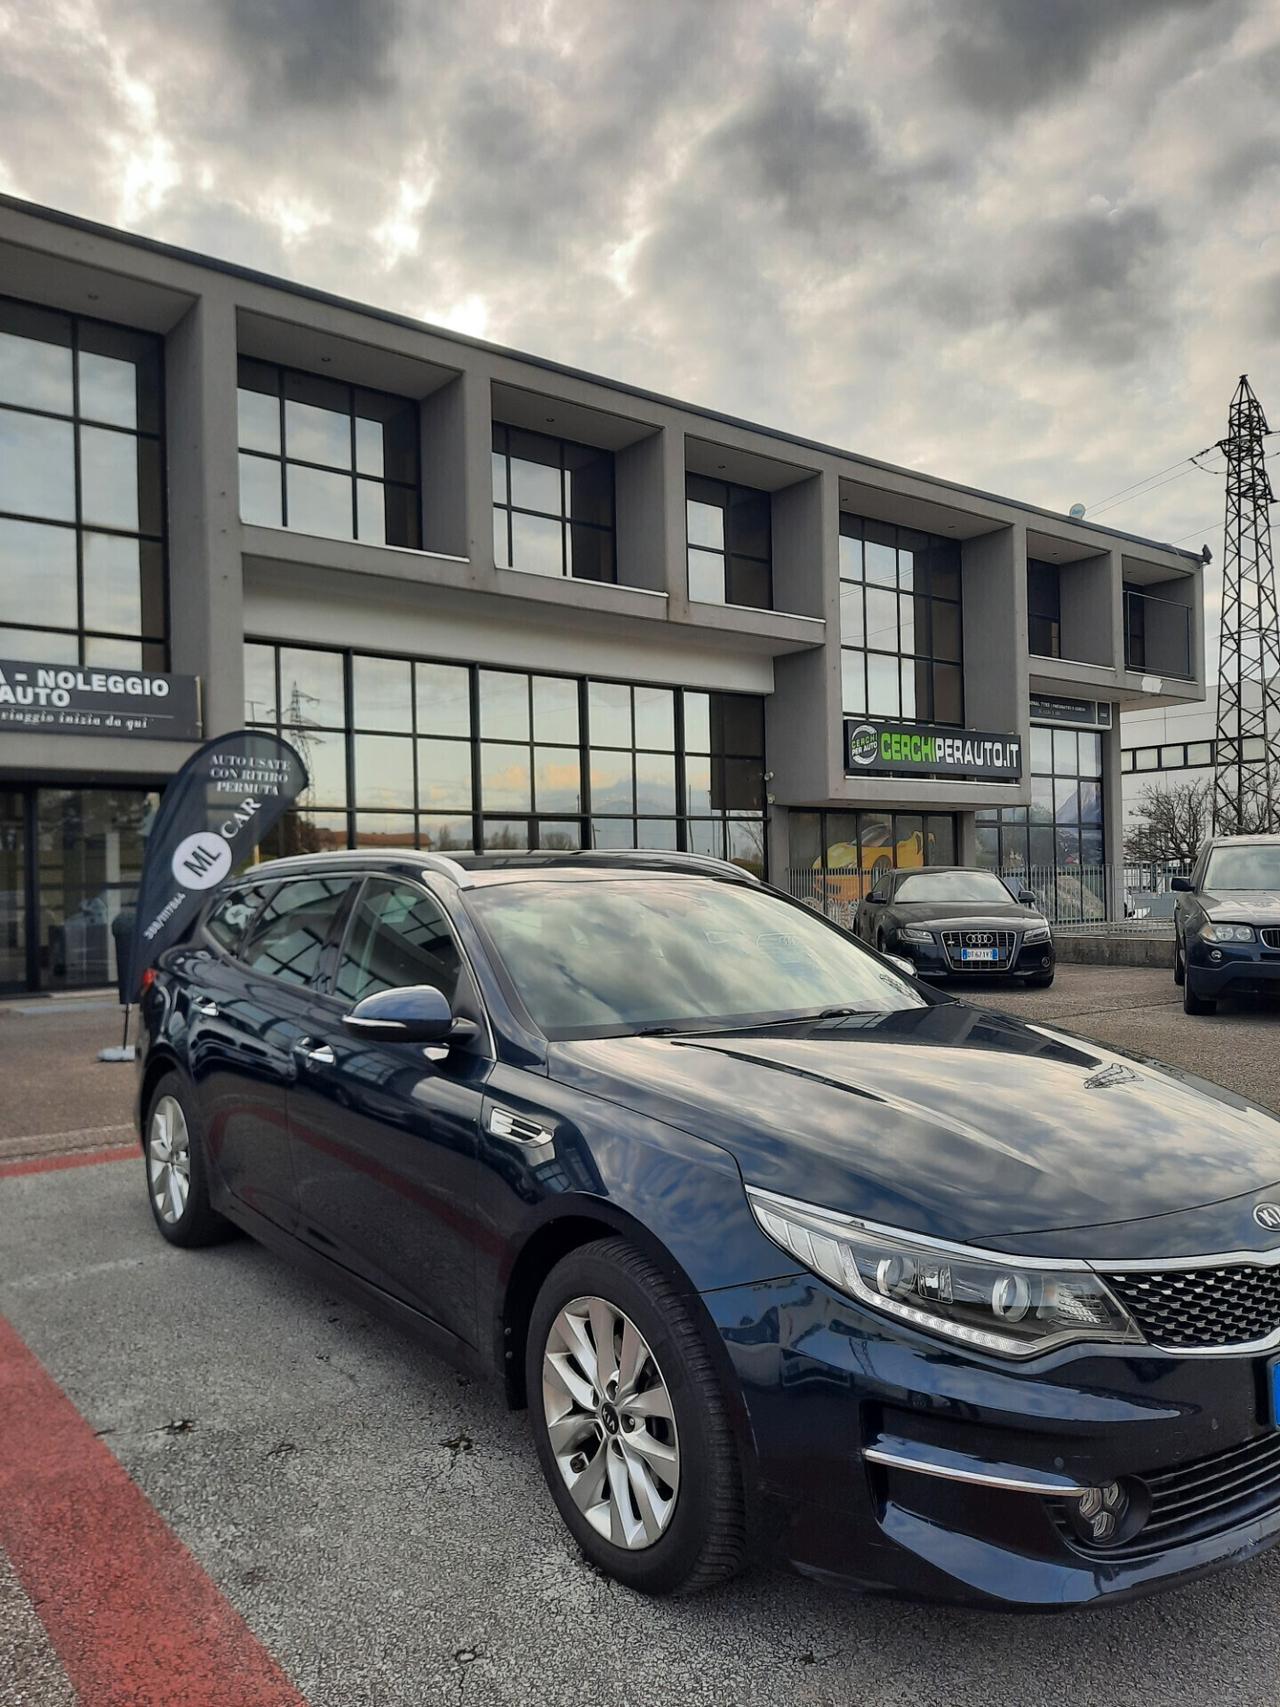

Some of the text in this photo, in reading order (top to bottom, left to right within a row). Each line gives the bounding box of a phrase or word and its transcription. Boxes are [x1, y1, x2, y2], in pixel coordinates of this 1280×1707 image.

[36, 668, 170, 698] NOLEGGIO
[0, 685, 71, 708] AUTO
[105, 714, 122, 727] da
[851, 733, 878, 749] CERCHI
[851, 741, 878, 757] PER AUTO
[209, 753, 291, 772] AUTO USATE
[209, 767, 289, 783] CON RITIRO
[216, 781, 279, 796] PERMUTA
[183, 797, 263, 878] ML CAR
